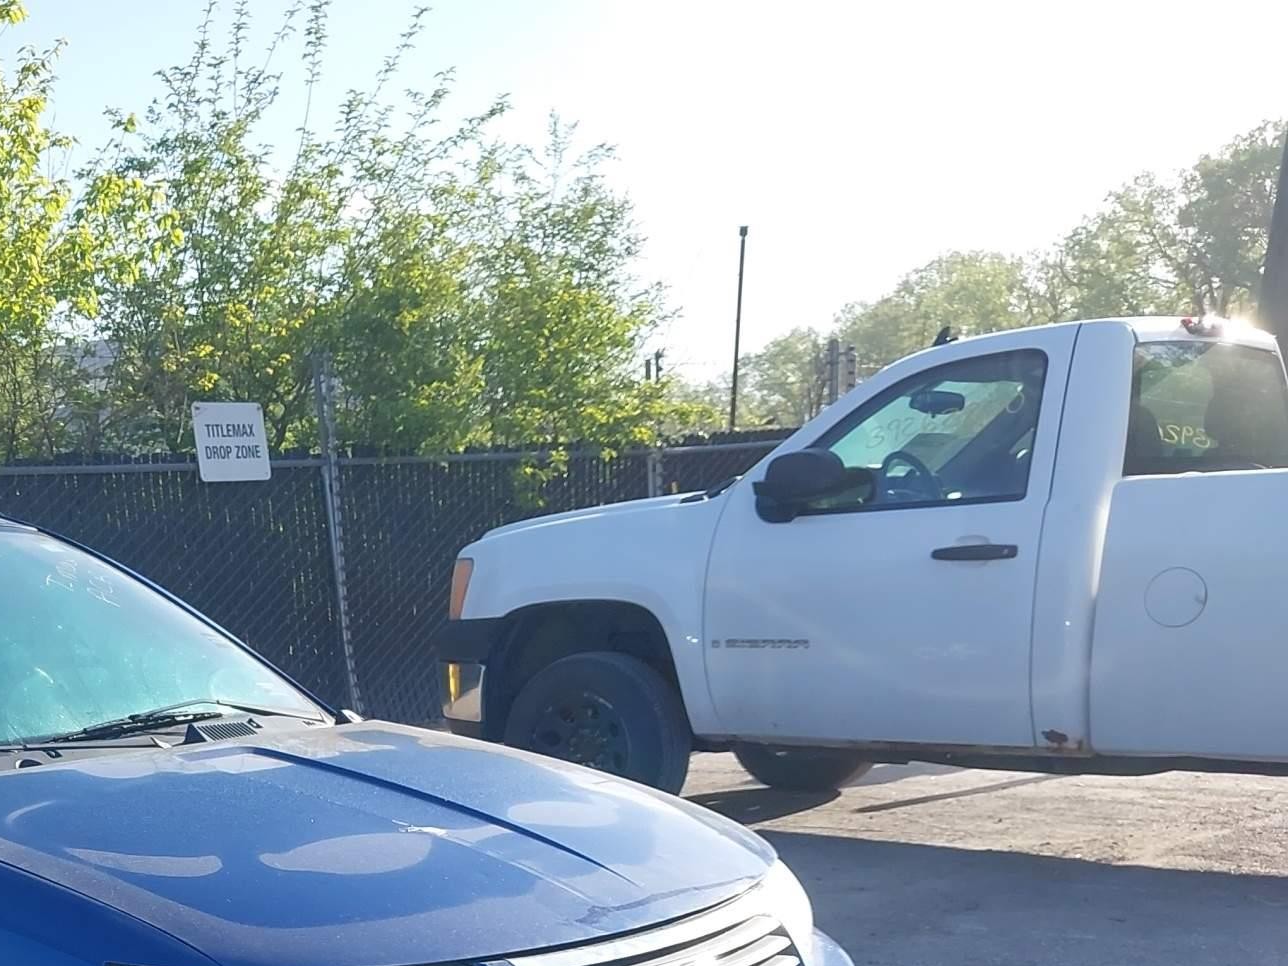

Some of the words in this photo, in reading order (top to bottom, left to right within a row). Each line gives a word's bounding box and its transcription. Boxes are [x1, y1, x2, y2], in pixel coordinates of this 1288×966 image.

[204, 424, 255, 438] TITLEMAX
[205, 445, 232, 460] DROP
[234, 445, 261, 459] ZONE
